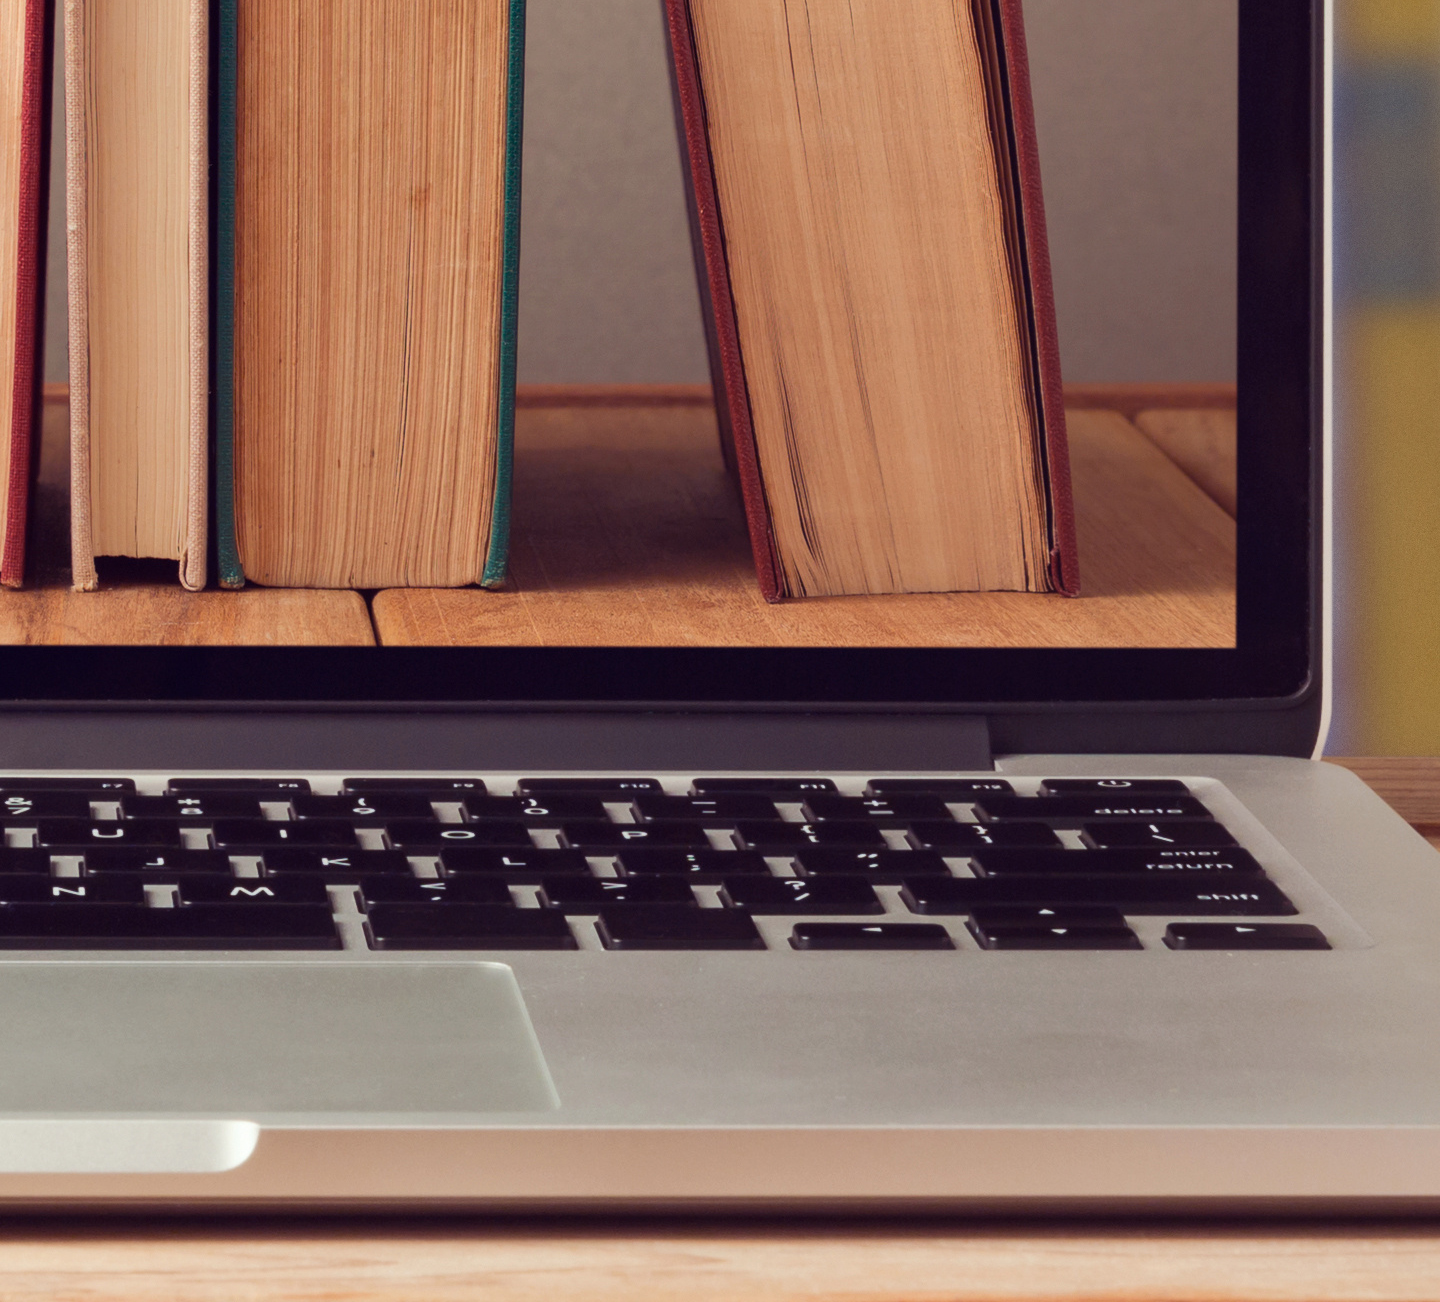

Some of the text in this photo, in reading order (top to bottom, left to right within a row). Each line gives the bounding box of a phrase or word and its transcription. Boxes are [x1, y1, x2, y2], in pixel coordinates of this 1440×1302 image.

[4, 796, 33, 806] &
[7, 806, 31, 815] 7
[180, 807, 204, 815] 8
[91, 828, 124, 839] U
[440, 830, 476, 839] O
[621, 830, 648, 840] P
[145, 857, 165, 866] J
[321, 857, 351, 867] K
[501, 856, 526, 866] L
[52, 886, 86, 897] N
[229, 886, 275, 897] M
[1196, 893, 1259, 901] shift
